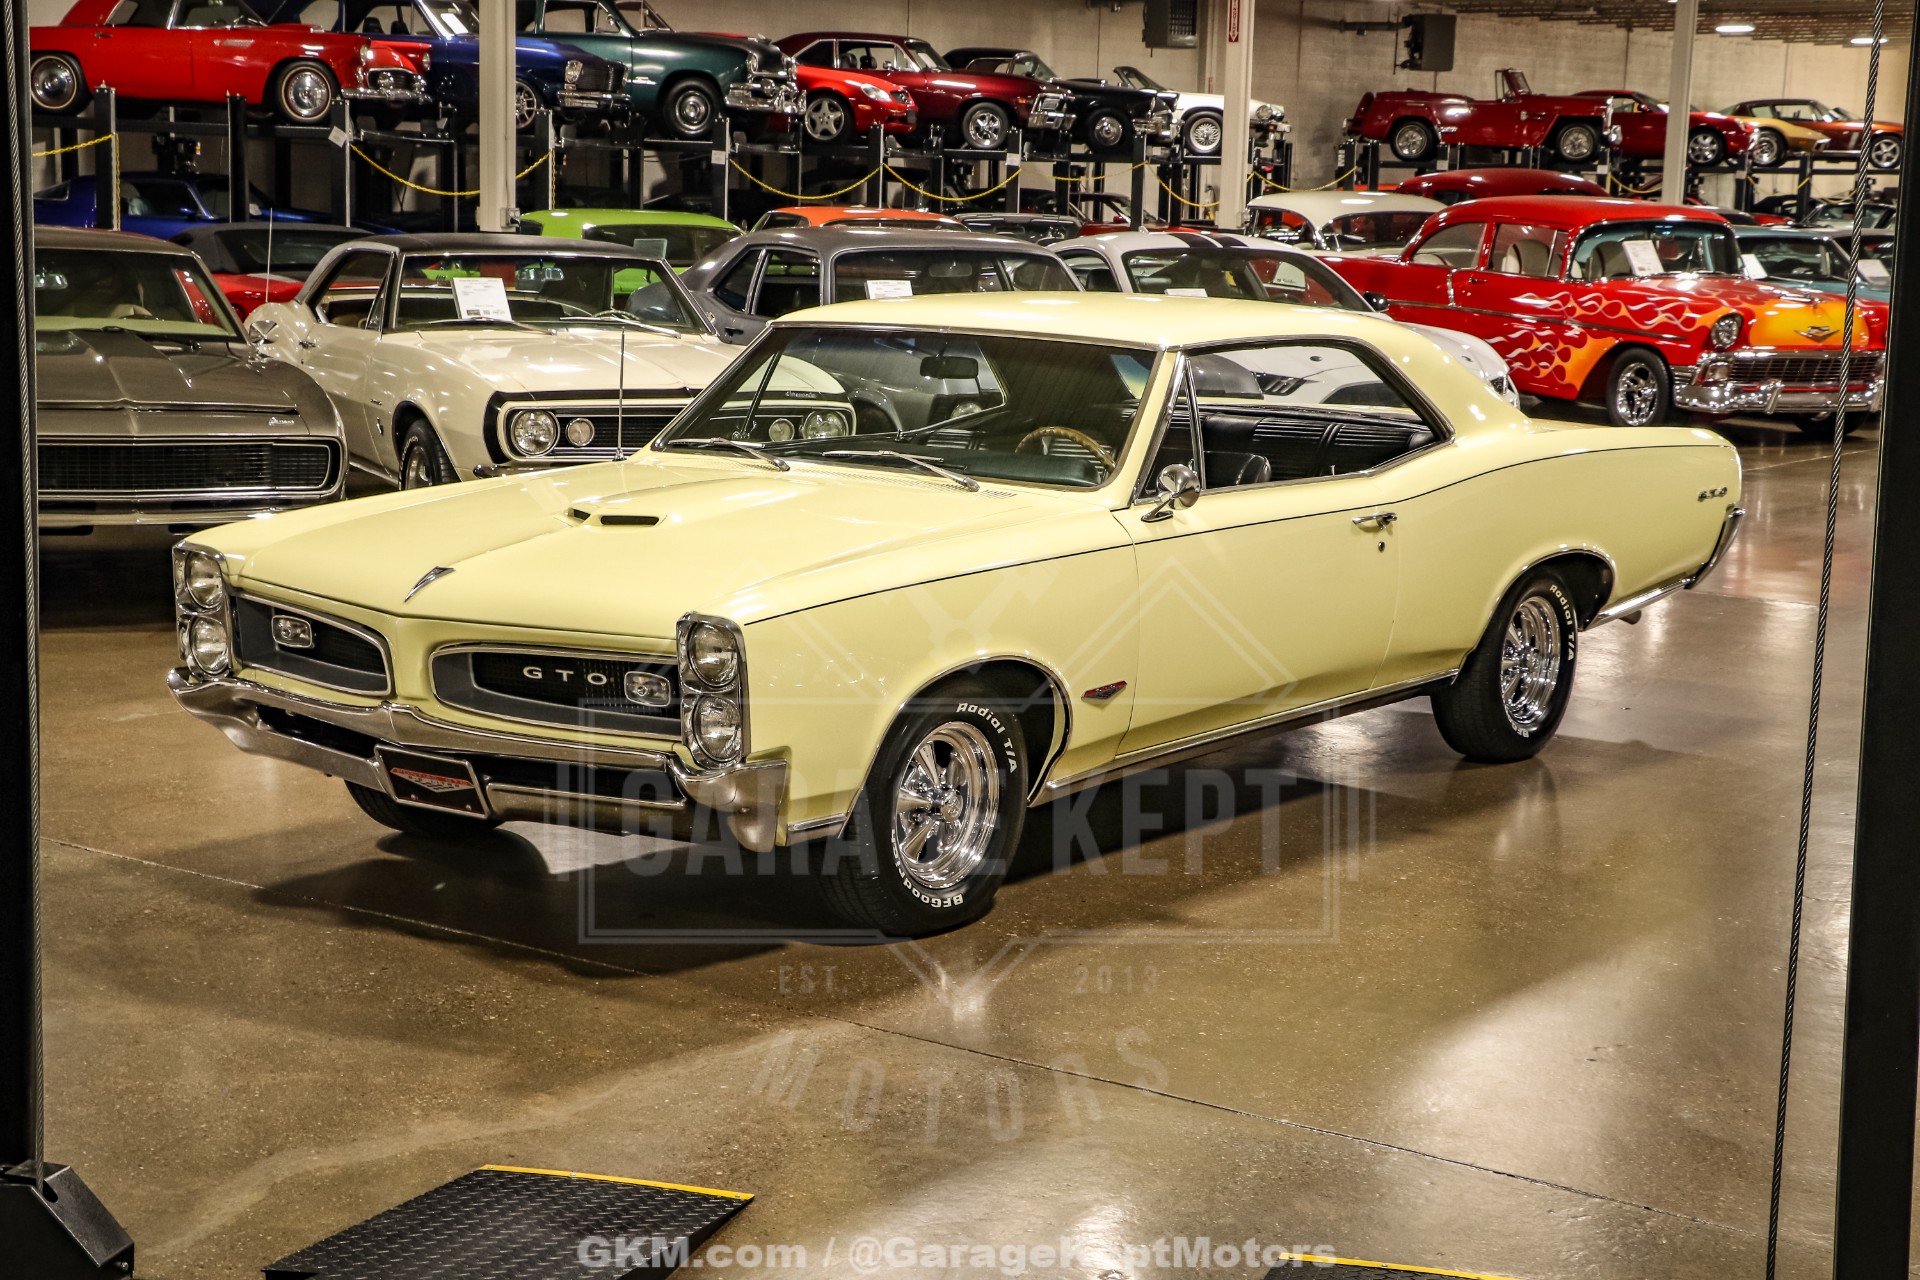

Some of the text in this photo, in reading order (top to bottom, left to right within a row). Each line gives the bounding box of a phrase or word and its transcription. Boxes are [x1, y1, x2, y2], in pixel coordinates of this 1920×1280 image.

[1550, 584, 1575, 661] Radial T/A
[522, 666, 607, 685] GTO
[956, 702, 1018, 773] Radial T/A
[891, 829, 964, 909] BFGoodrich
